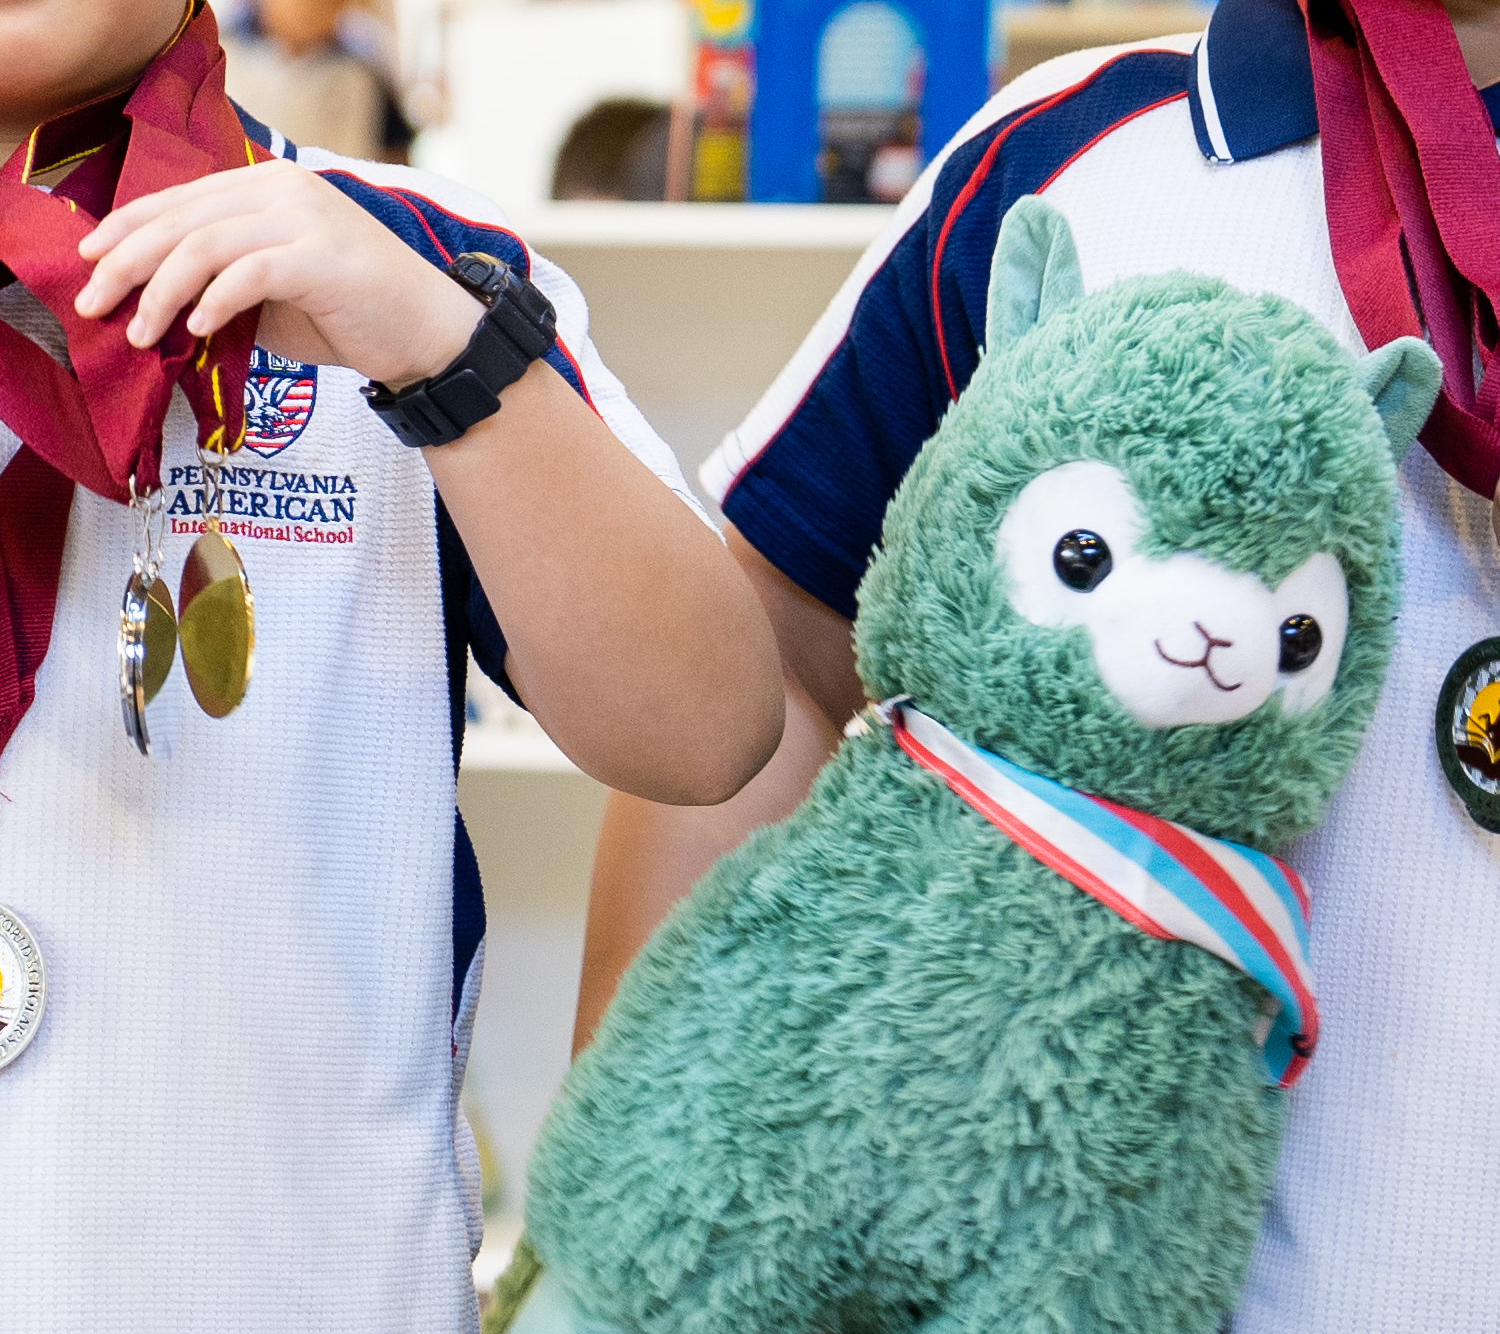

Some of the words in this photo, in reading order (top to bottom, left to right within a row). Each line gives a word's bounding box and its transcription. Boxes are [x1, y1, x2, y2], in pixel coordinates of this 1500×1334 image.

[167, 489, 356, 523] AMERICAN
[171, 518, 290, 542] Intenational
[294, 526, 354, 544] School
